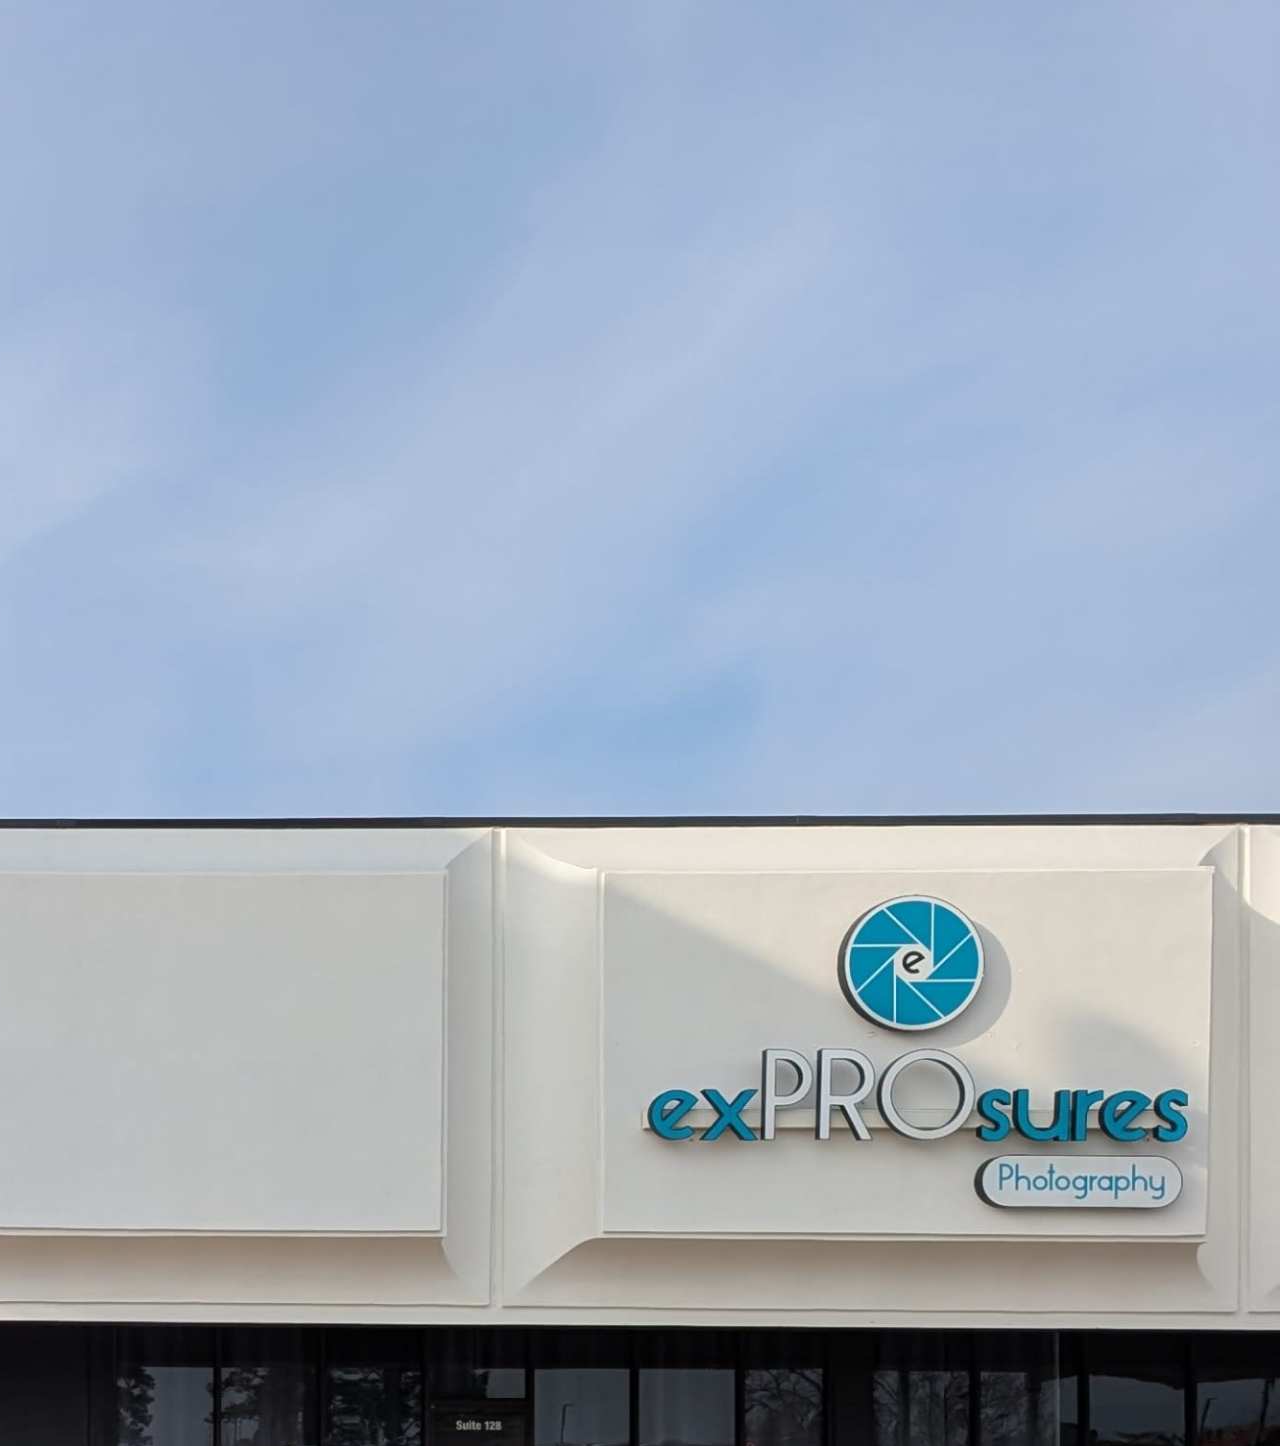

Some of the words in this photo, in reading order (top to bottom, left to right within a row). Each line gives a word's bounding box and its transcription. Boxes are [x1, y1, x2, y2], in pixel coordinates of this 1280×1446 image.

[647, 1047, 1190, 1143] exPROsures
[998, 1162, 1167, 1200] Photography
[455, 1420, 482, 1431] Suite
